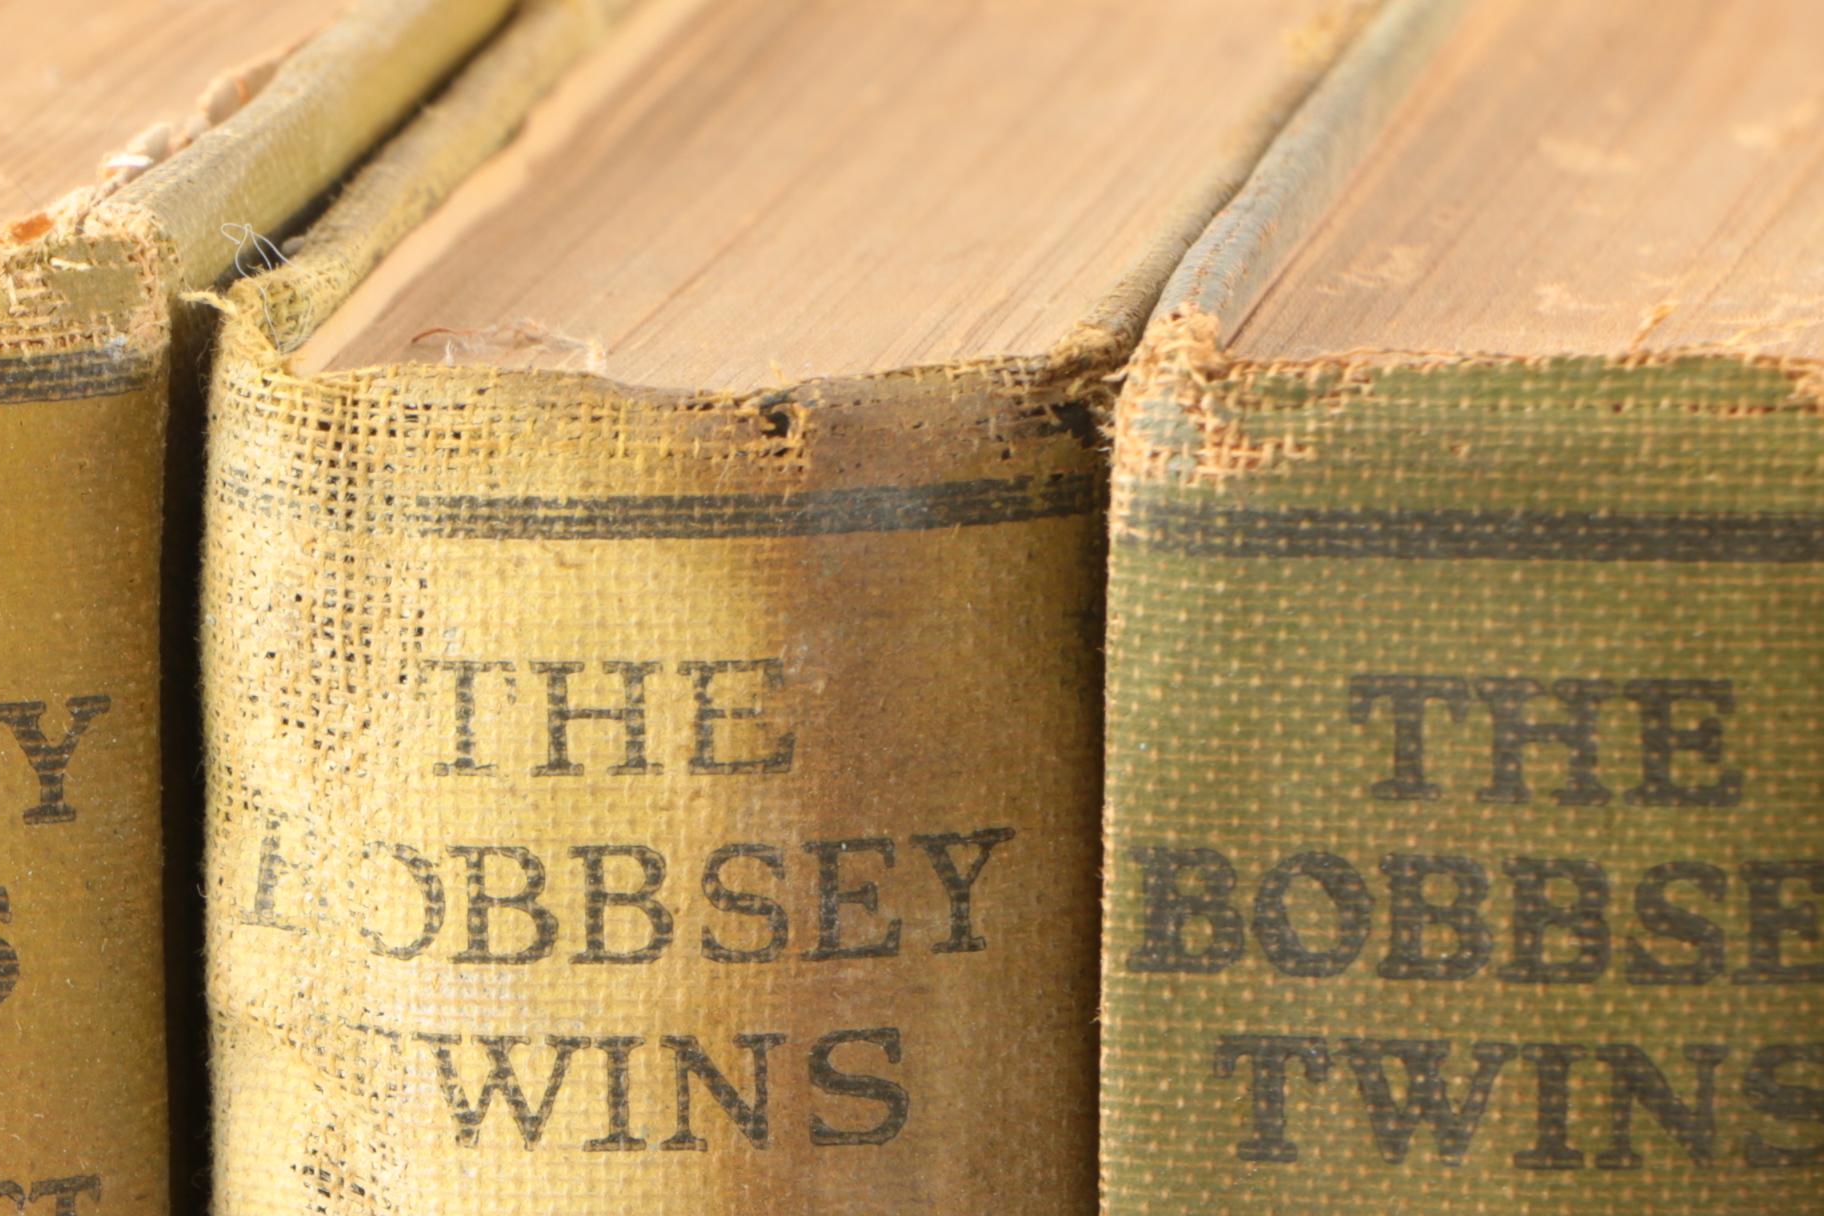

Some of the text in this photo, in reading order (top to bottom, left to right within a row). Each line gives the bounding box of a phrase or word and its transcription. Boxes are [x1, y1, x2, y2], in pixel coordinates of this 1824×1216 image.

[416, 657, 797, 777] THE
[1347, 674, 1743, 808] THE
[338, 1018, 911, 1152] WINS
[1213, 1034, 1824, 1171] TWINS
